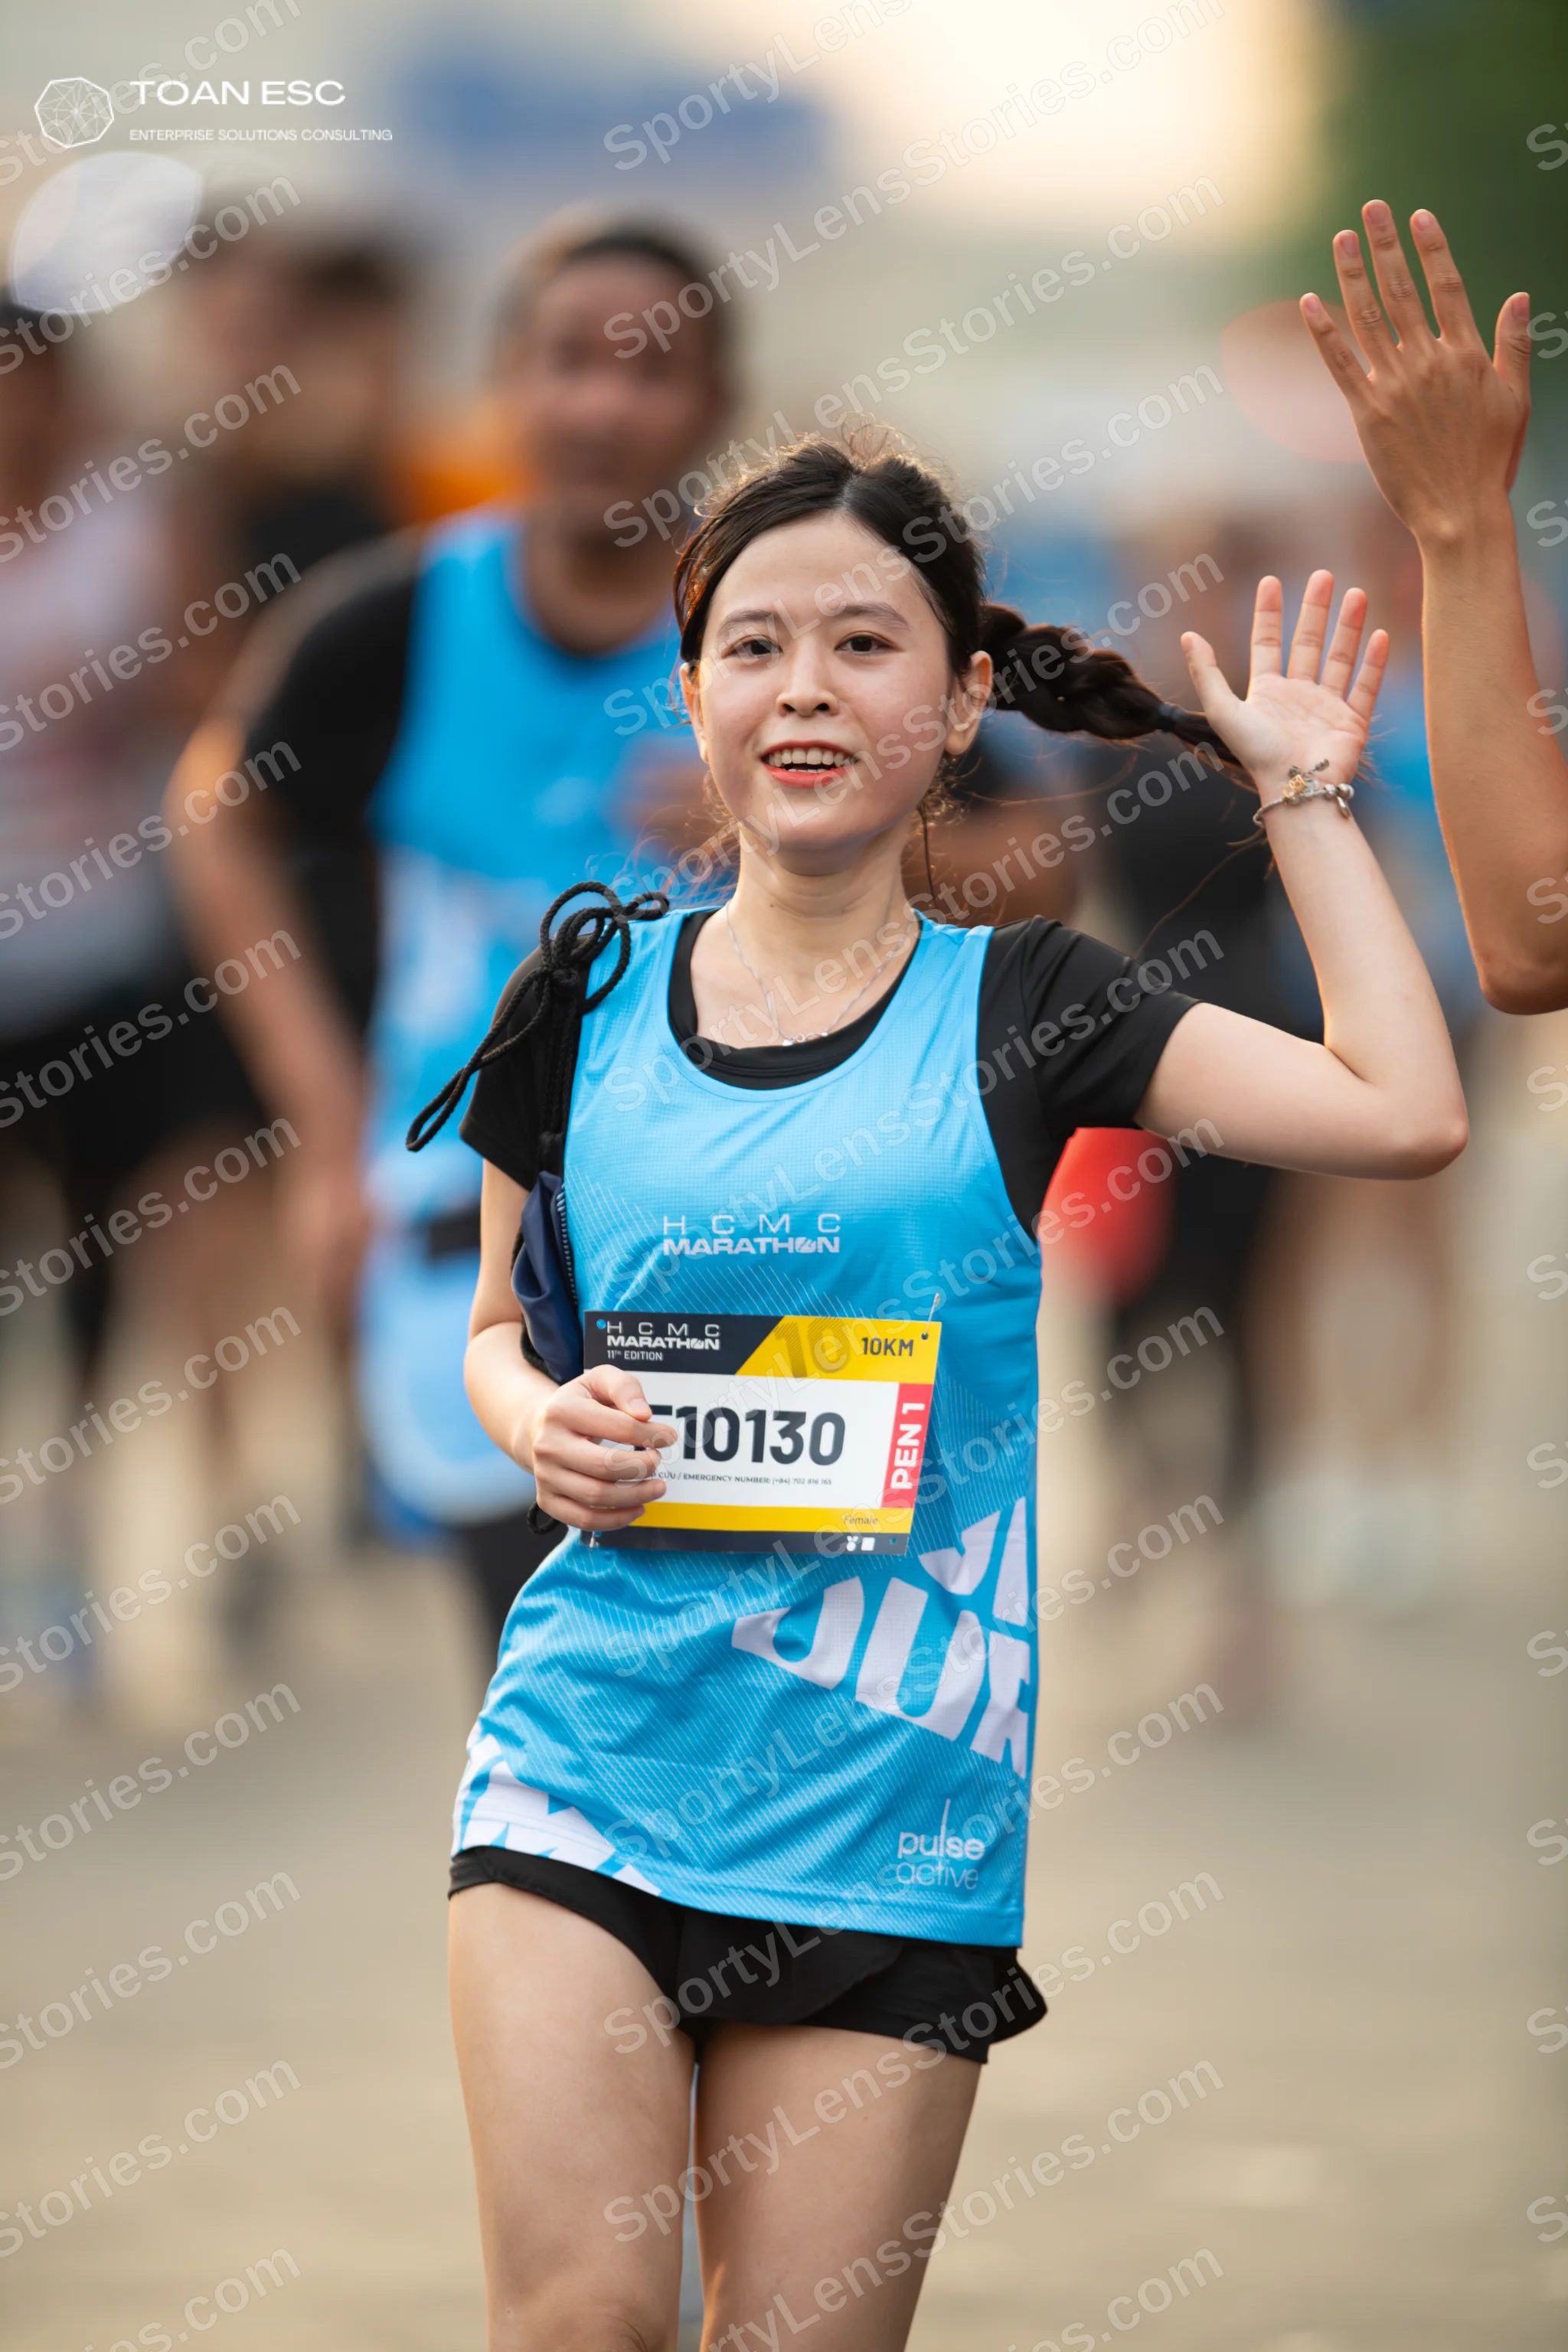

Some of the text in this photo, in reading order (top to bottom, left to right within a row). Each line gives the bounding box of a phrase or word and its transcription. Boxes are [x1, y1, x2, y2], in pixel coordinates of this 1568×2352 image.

[663, 1236, 840, 1256] MARATHON
[606, 1334, 720, 1351] MARATHON
[861, 1337, 914, 1357] 10KM
[624, 1351, 664, 1361] EDITION
[890, 1403, 926, 1489] PEN 1
[683, 1473, 733, 1482] EMERGENCY
[734, 1475, 770, 1484] NUMBER:
[843, 1514, 879, 1525] Female
[897, 1798, 985, 1860] pulse
[896, 1859, 978, 1890] active
